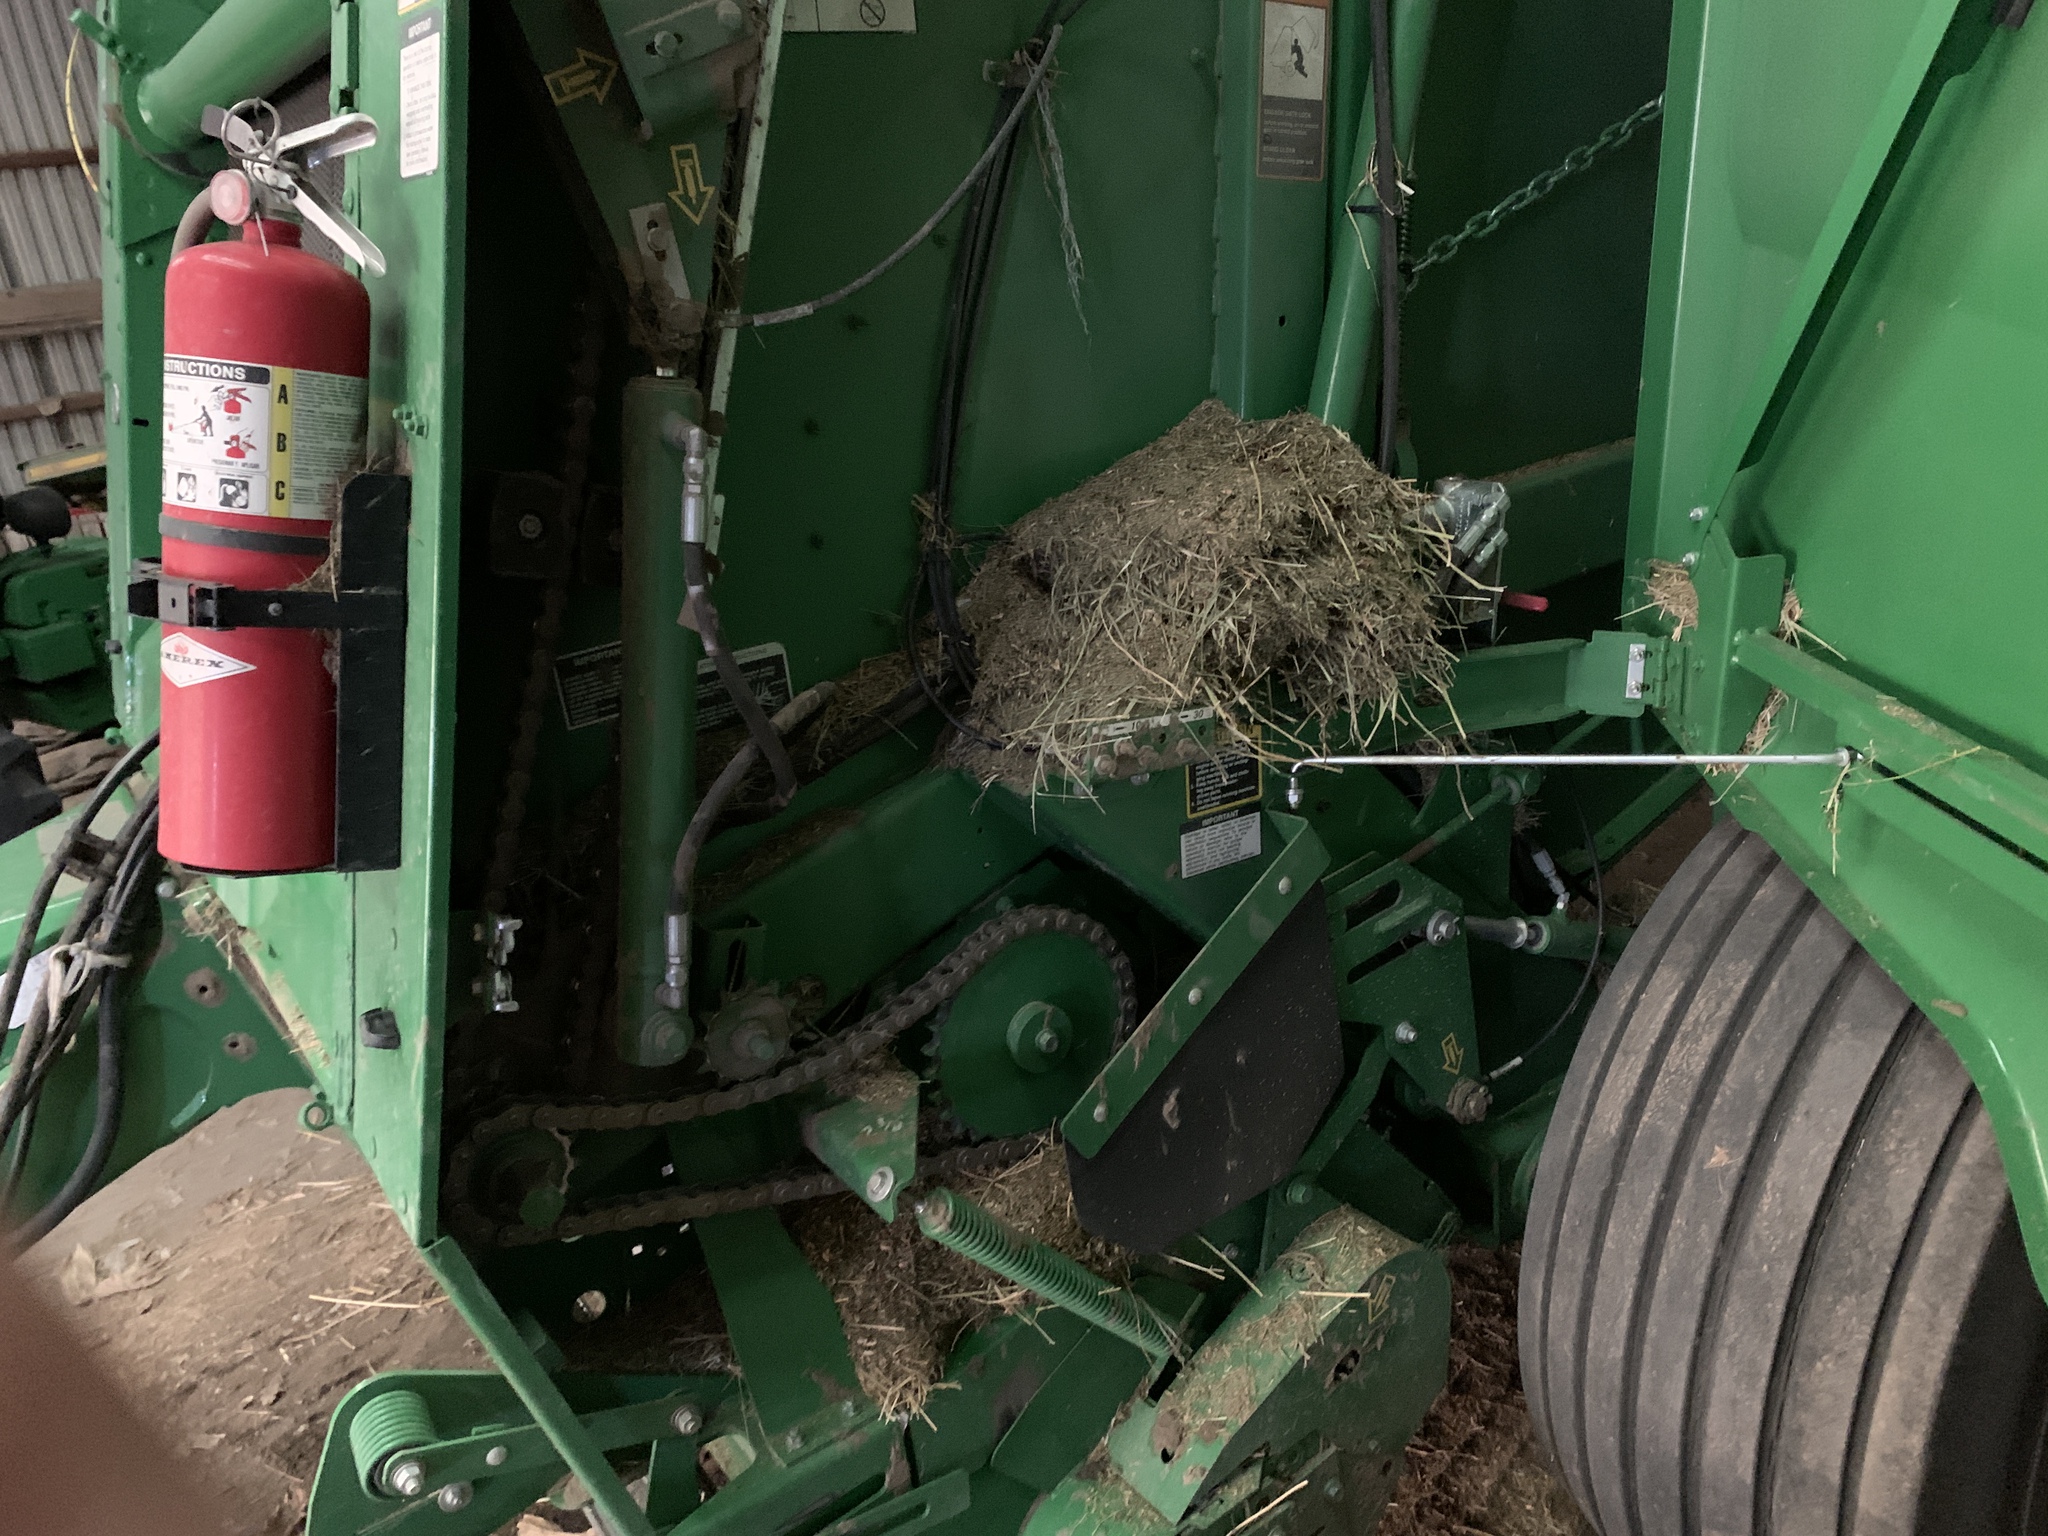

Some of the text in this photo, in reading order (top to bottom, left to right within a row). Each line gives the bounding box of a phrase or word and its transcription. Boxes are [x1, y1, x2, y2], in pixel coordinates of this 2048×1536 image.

[277, 384, 289, 405] A
[276, 433, 287, 452] B
[275, 480, 286, 500] C
[1193, 709, 1204, 719] 30
[1201, 809, 1239, 827] IMPORTANT
